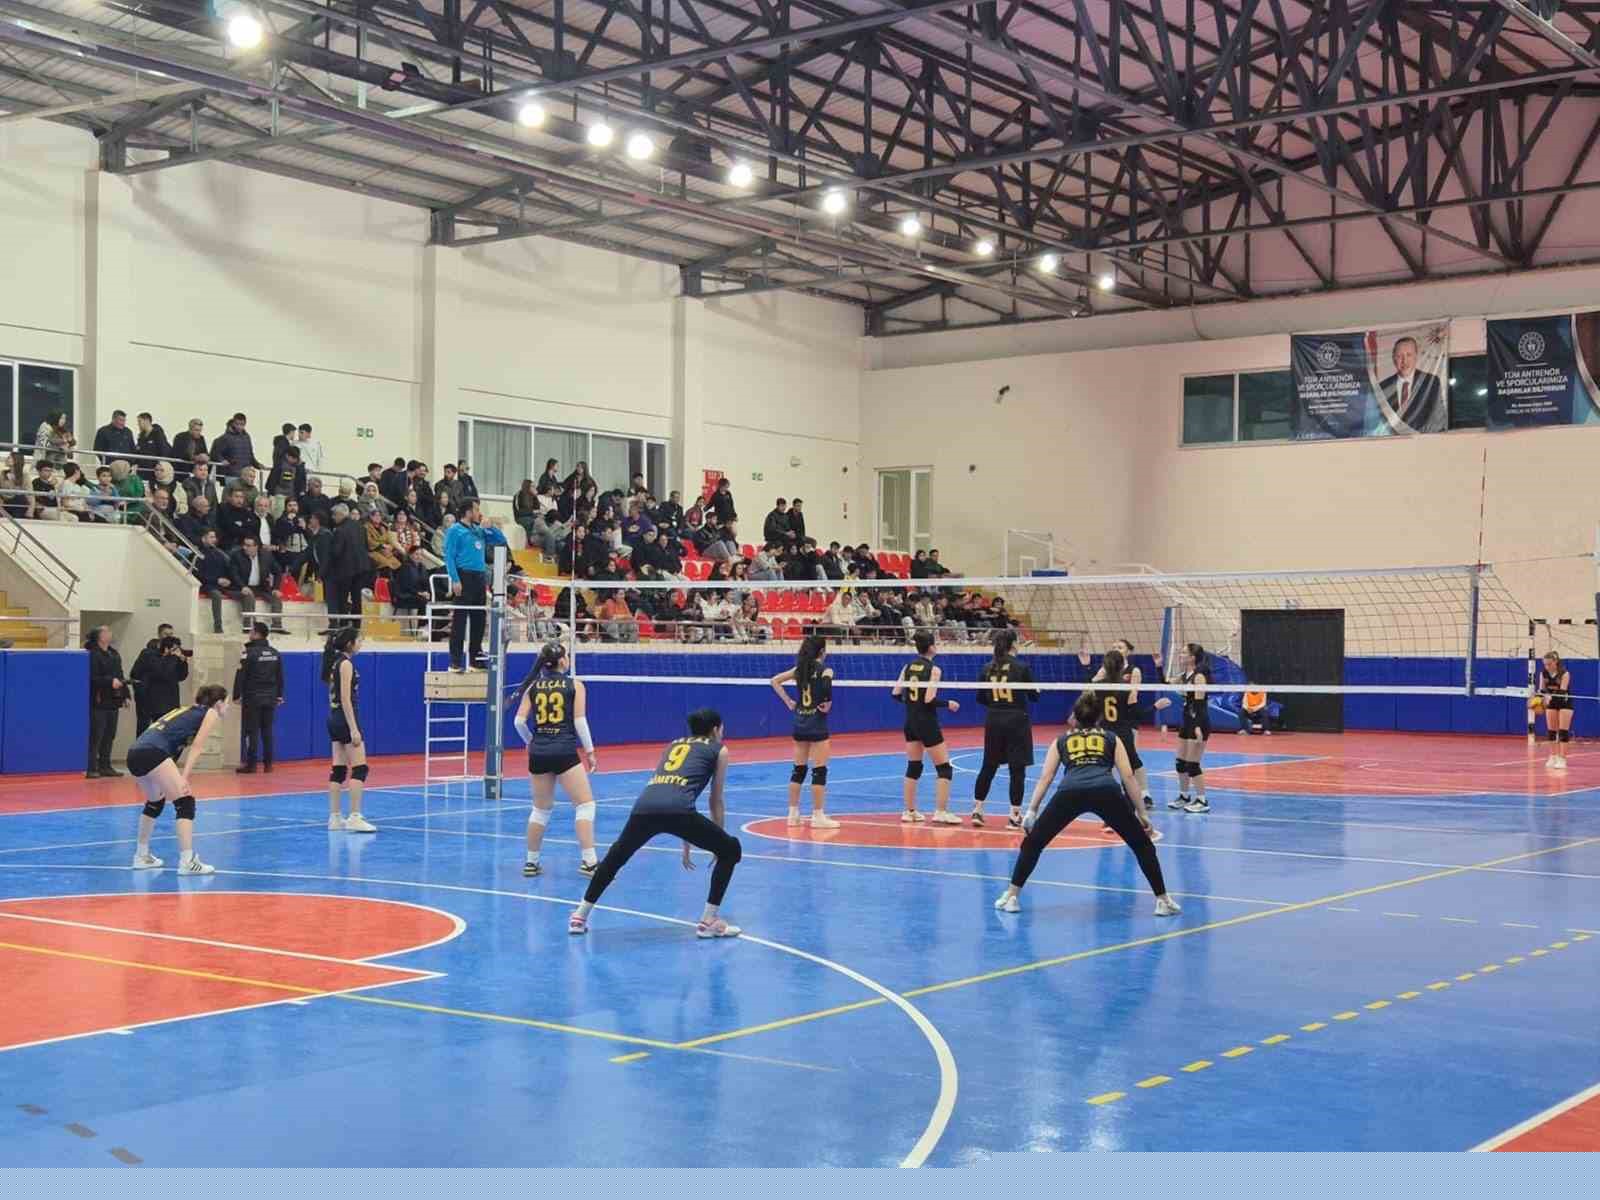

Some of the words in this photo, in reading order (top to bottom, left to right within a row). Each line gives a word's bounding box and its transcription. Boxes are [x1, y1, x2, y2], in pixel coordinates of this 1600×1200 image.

[535, 692, 565, 725] 33
[1104, 696, 1118, 723] 6
[664, 743, 691, 772] 9
[1066, 735, 1105, 760] 99
